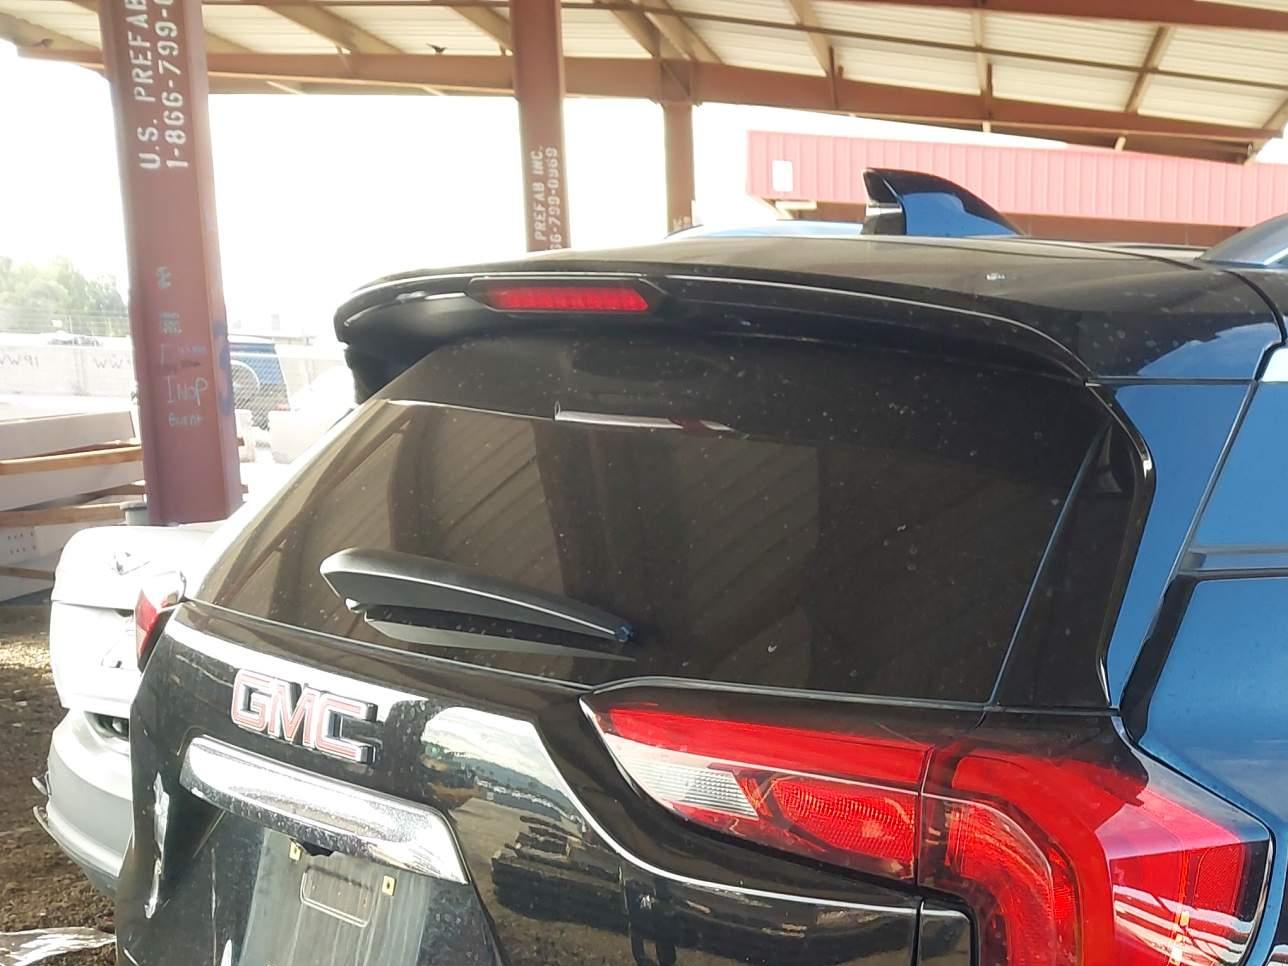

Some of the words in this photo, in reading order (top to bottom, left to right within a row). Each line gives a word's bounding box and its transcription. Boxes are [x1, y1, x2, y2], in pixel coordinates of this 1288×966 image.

[124, 0, 156, 102] PREFAB
[137, 119, 161, 170] U.S.
[530, 145, 545, 176] INC.
[532, 182, 548, 241] PREFAB
[231, 668, 378, 766] GMC
